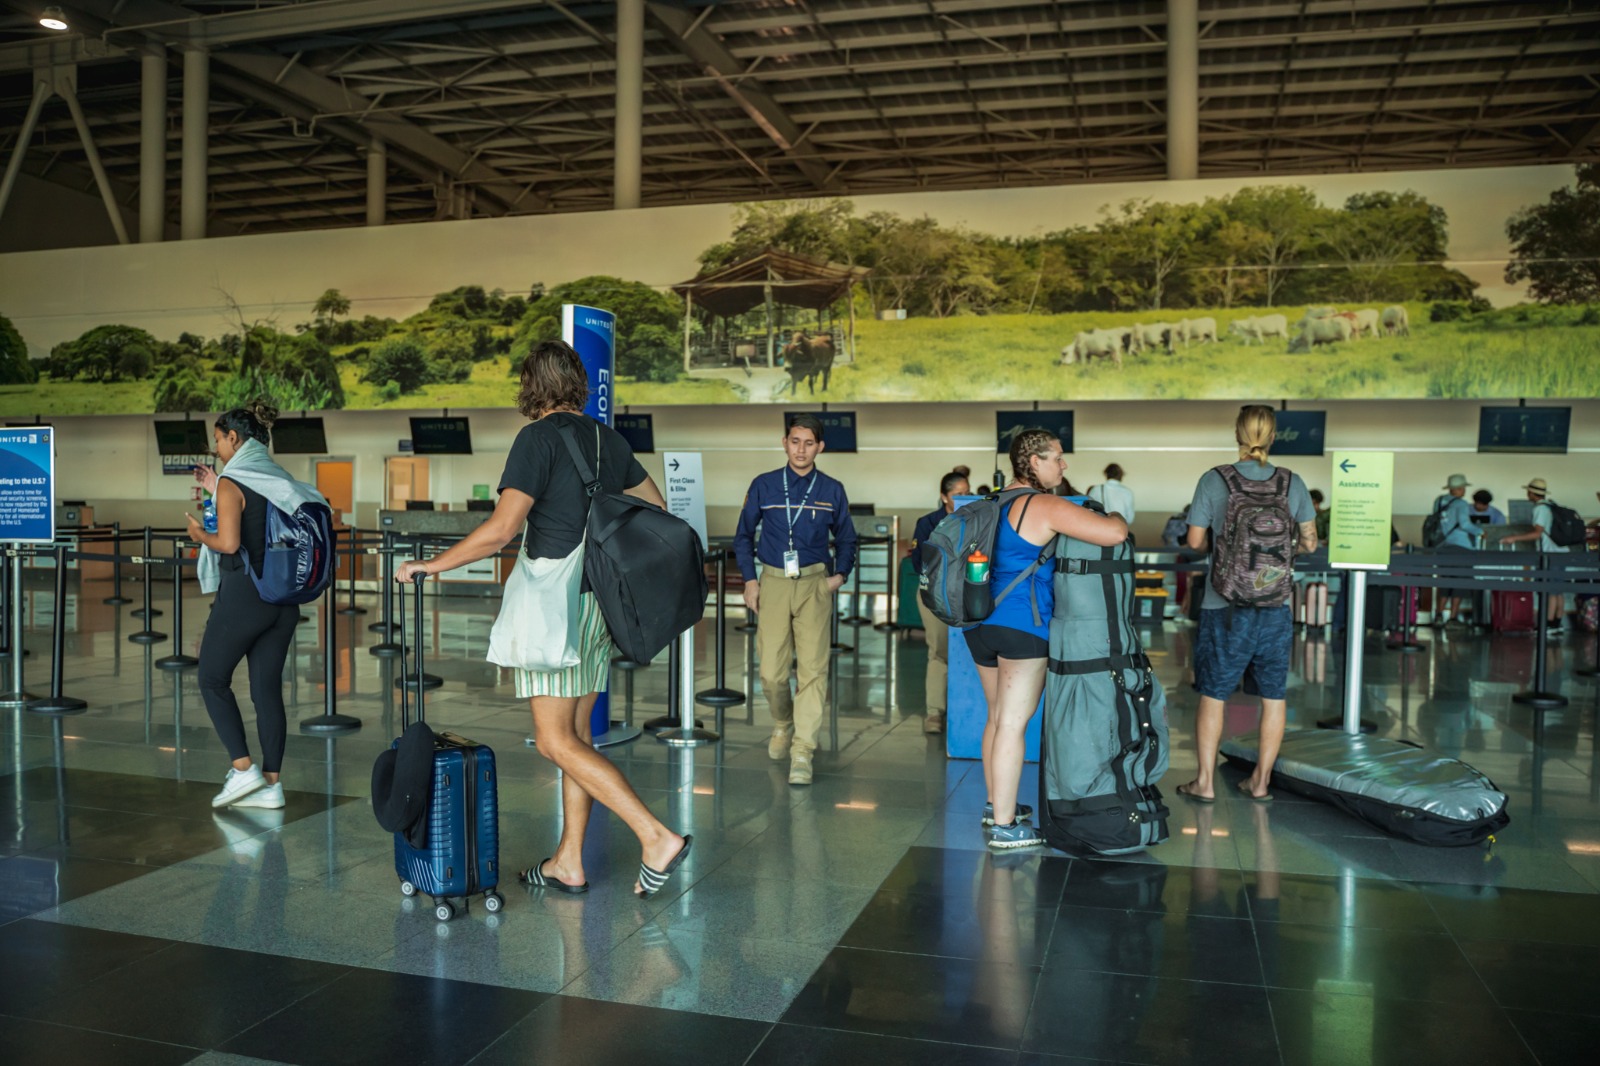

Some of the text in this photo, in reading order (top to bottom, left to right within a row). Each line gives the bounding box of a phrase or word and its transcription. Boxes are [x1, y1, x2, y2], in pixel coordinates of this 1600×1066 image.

[585, 317, 610, 329] UNITED
[21, 477, 31, 485] the
[32, 477, 46, 485] U.S.?
